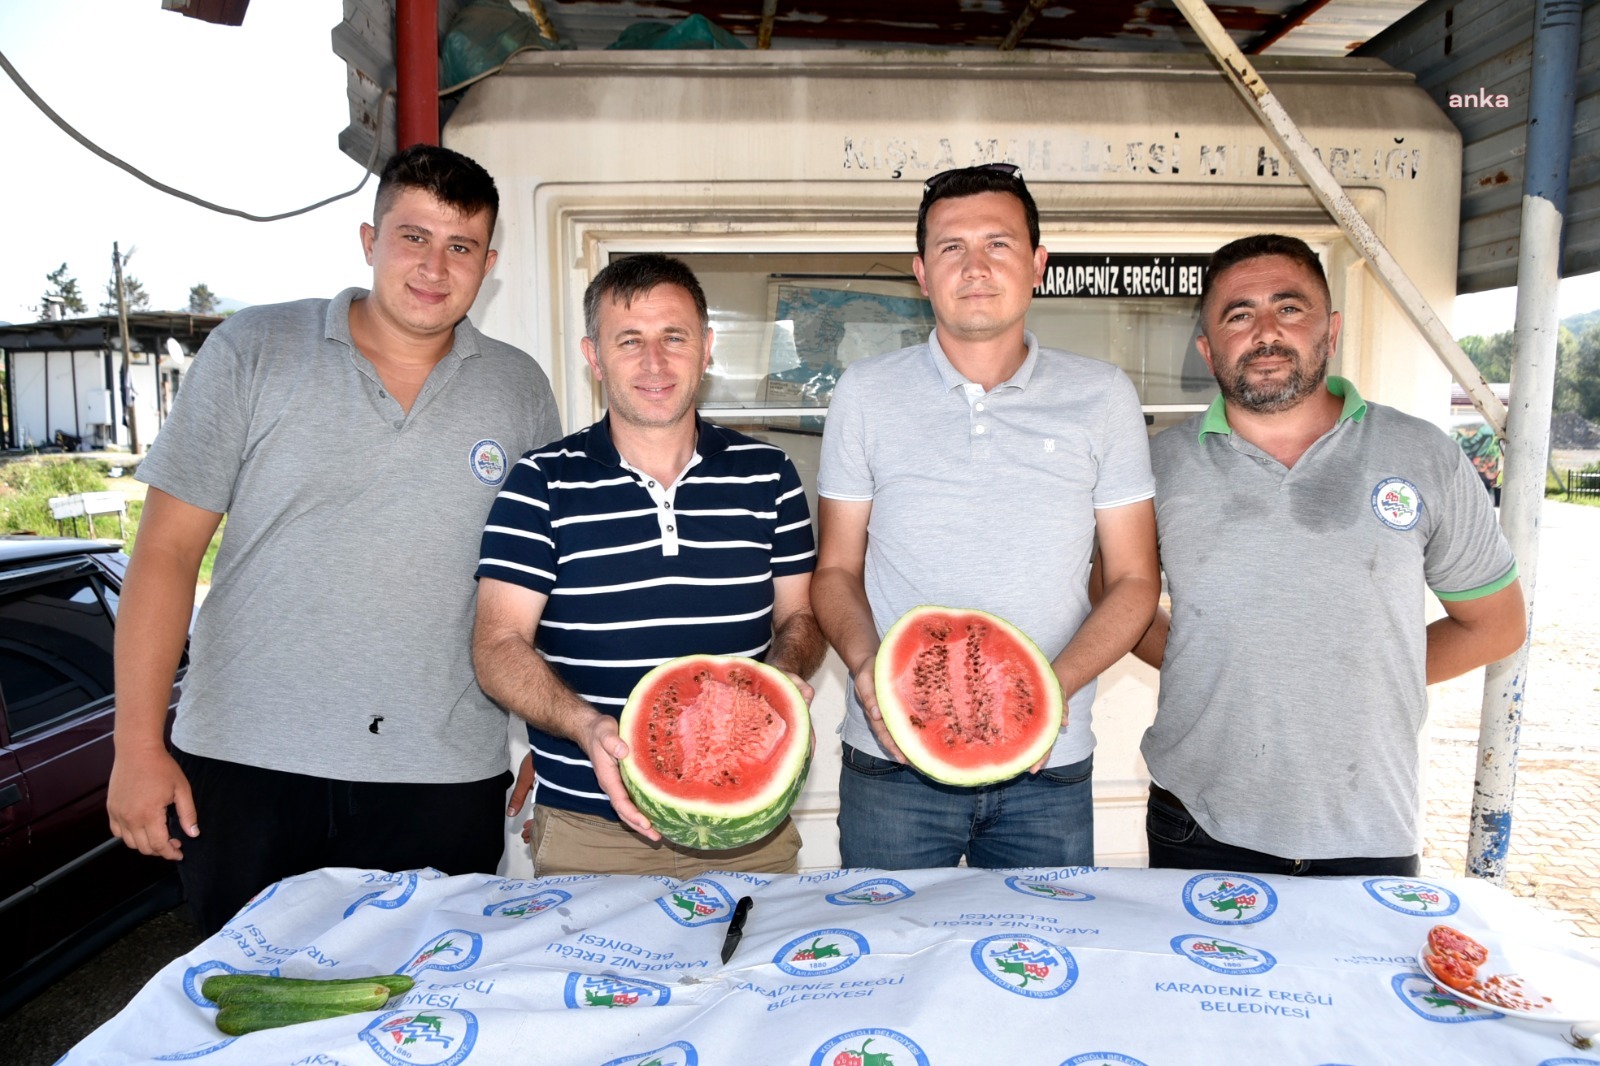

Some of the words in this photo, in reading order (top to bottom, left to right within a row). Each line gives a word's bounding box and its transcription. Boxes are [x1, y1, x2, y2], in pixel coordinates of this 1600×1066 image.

[971, 130, 1180, 174] MAHLLESİ
[1123, 256, 1175, 296] EREĞLİ
[959, 913, 1058, 924] BELEDİYESİ
[1000, 921, 1100, 935] KARADENİZ
[544, 942, 606, 964] EREĞLİ
[575, 933, 675, 961] BELEDİYESİ
[609, 956, 708, 972] KARADENİZ
[840, 973, 905, 989] EREĞLİ
[767, 987, 875, 1012] BELEDİYESİ
[1154, 981, 1263, 999] KARADENİZ
[1268, 988, 1334, 1007] EREĞLİ
[1200, 999, 1310, 1020] BELEDİYESİ
[393, 1045, 413, 1059] 1880
